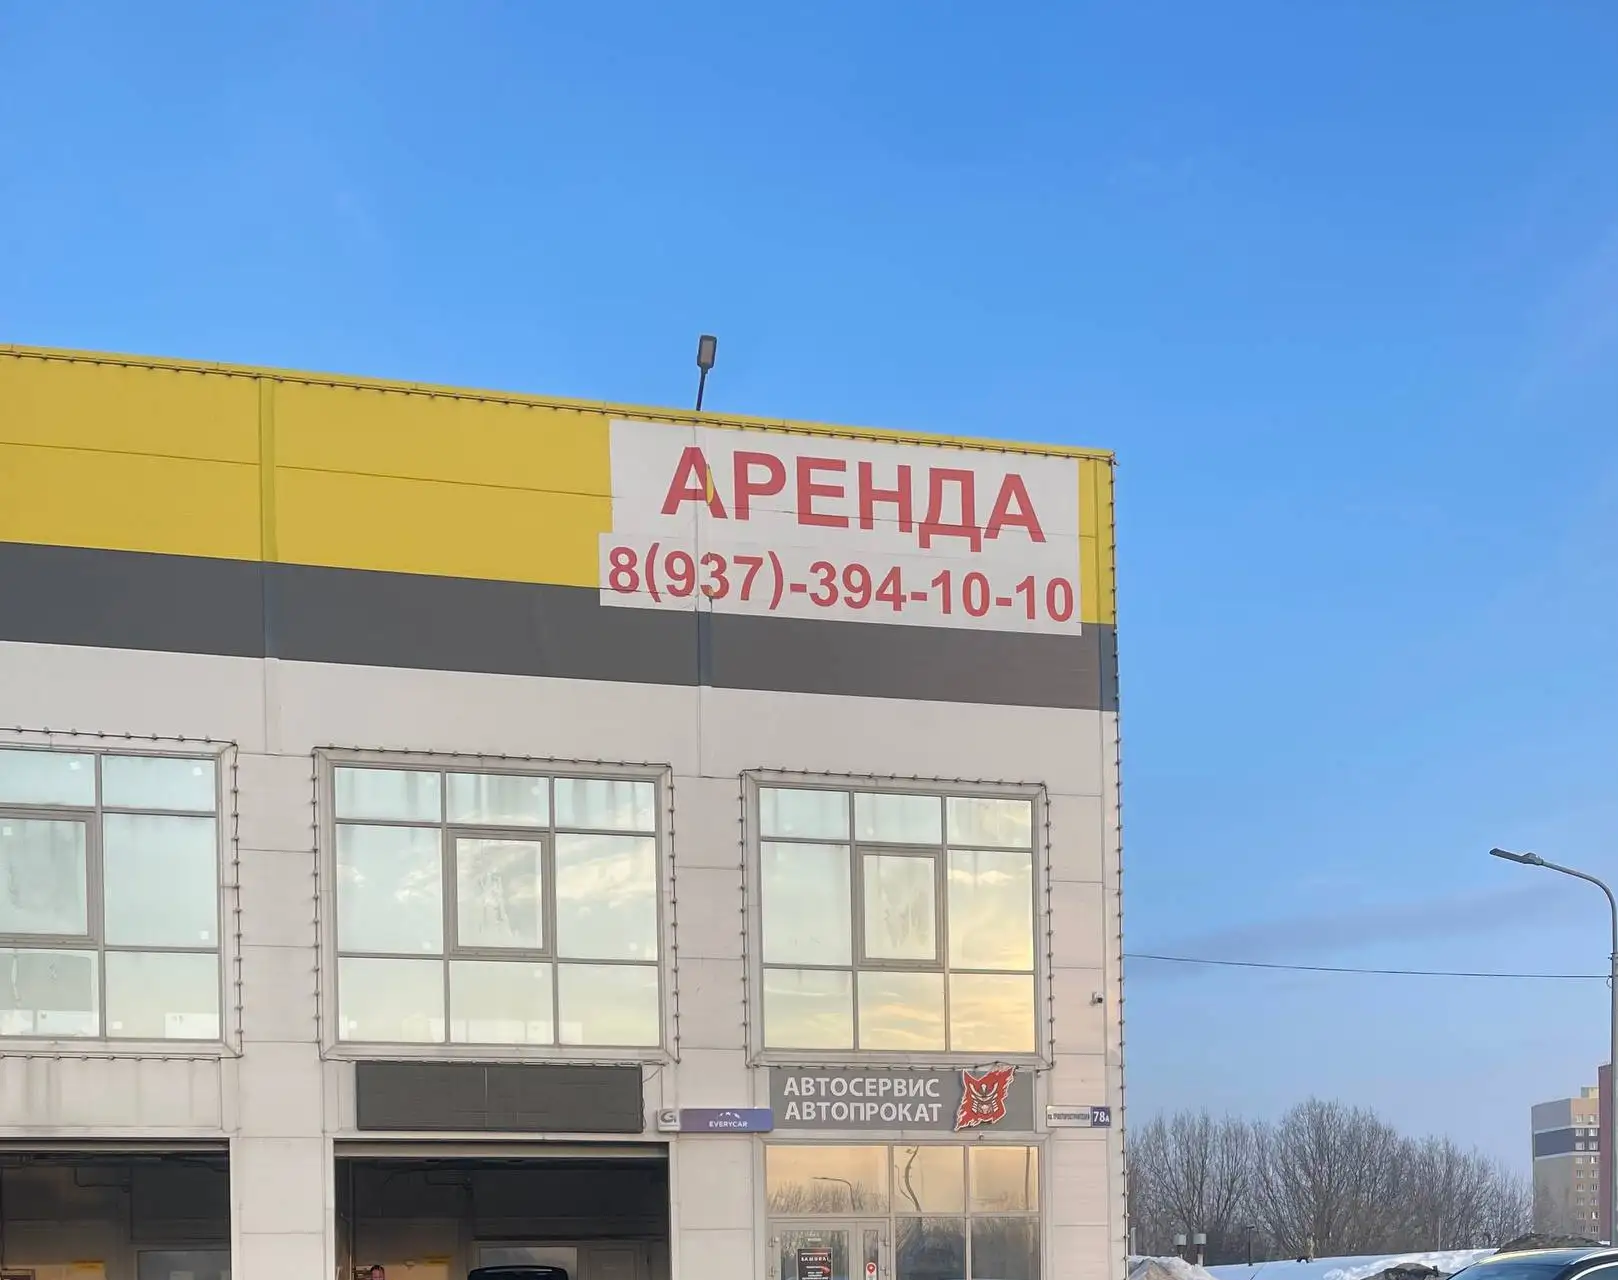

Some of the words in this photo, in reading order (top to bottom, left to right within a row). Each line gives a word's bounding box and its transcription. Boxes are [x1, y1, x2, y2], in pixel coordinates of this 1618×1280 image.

[660, 446, 1046, 552] АРЕНДА
[608, 542, 1074, 622] 8(937)-394-10-10
[784, 1077, 940, 1097] АВТОСЕРВИС
[785, 1102, 943, 1122] АВТОПРОКАТ
